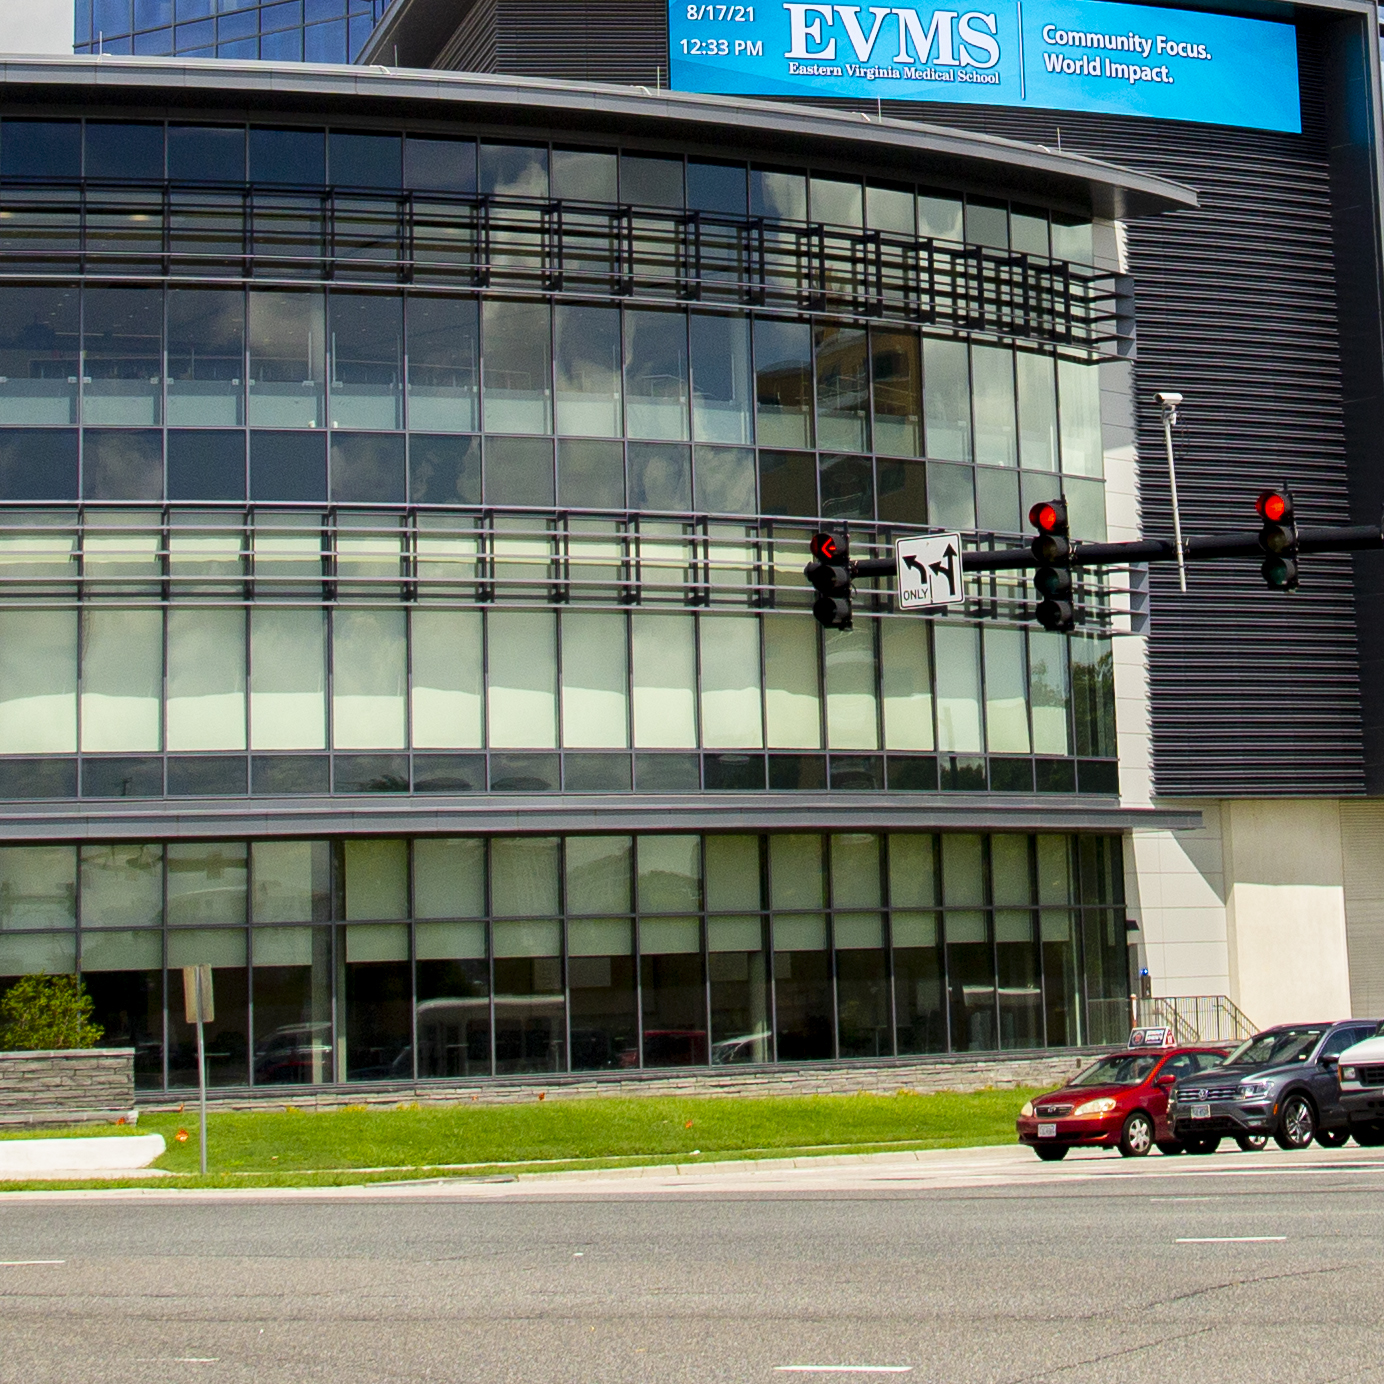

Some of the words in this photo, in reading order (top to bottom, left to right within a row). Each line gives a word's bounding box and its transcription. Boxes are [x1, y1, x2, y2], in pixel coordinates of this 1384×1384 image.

[686, 4, 755, 22] 8/17/21
[782, 2, 1001, 69] EVMS
[1042, 24, 1153, 58] Community
[1156, 35, 1213, 60] Focus.
[680, 38, 729, 56] 12:33
[734, 39, 763, 57] PM
[788, 62, 842, 77] Eastern
[845, 64, 901, 81] Virginia
[903, 68, 954, 82] Medical
[957, 70, 1000, 85] School
[1043, 52, 1102, 77] World
[1105, 58, 1175, 85] Impact.
[903, 587, 929, 601] ONLY
